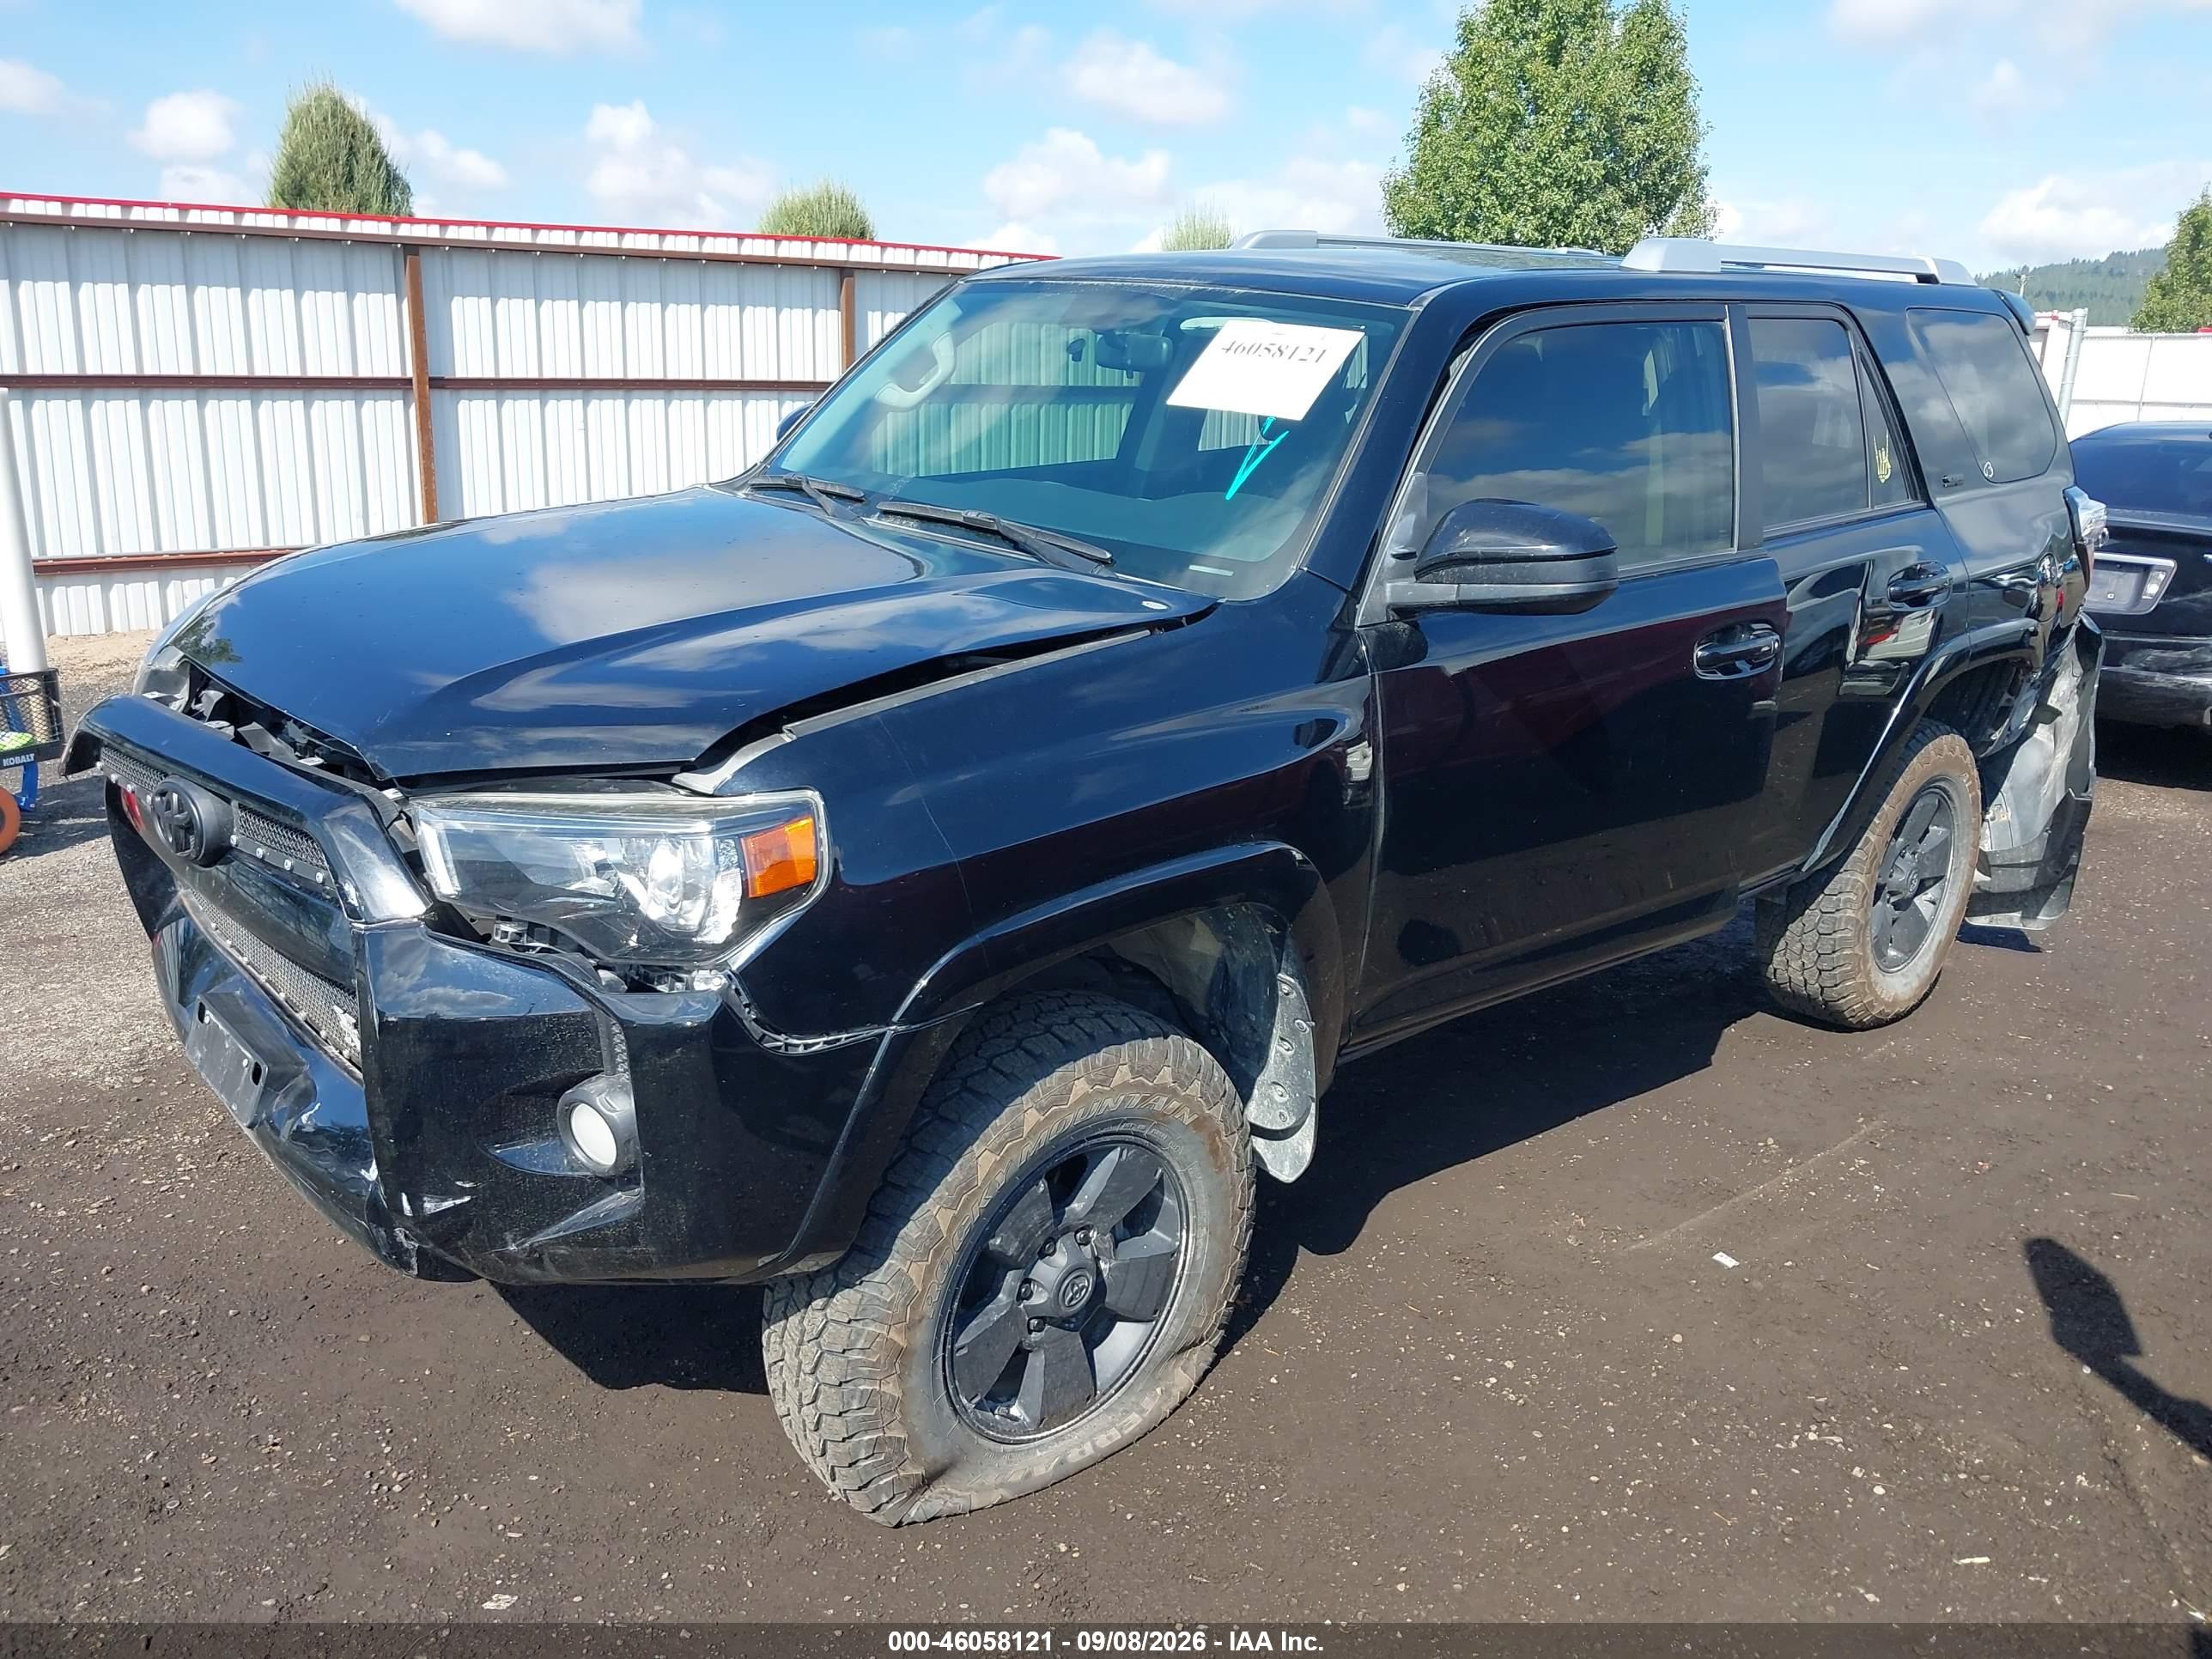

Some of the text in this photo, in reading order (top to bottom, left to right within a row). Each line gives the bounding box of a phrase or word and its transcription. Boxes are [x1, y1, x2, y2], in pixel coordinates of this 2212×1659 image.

[1221, 340, 1327, 363] 46058121
[3, 753, 35, 767] KOBALT
[921, 1092, 1200, 1319] ROCKY MOUNTAIN
